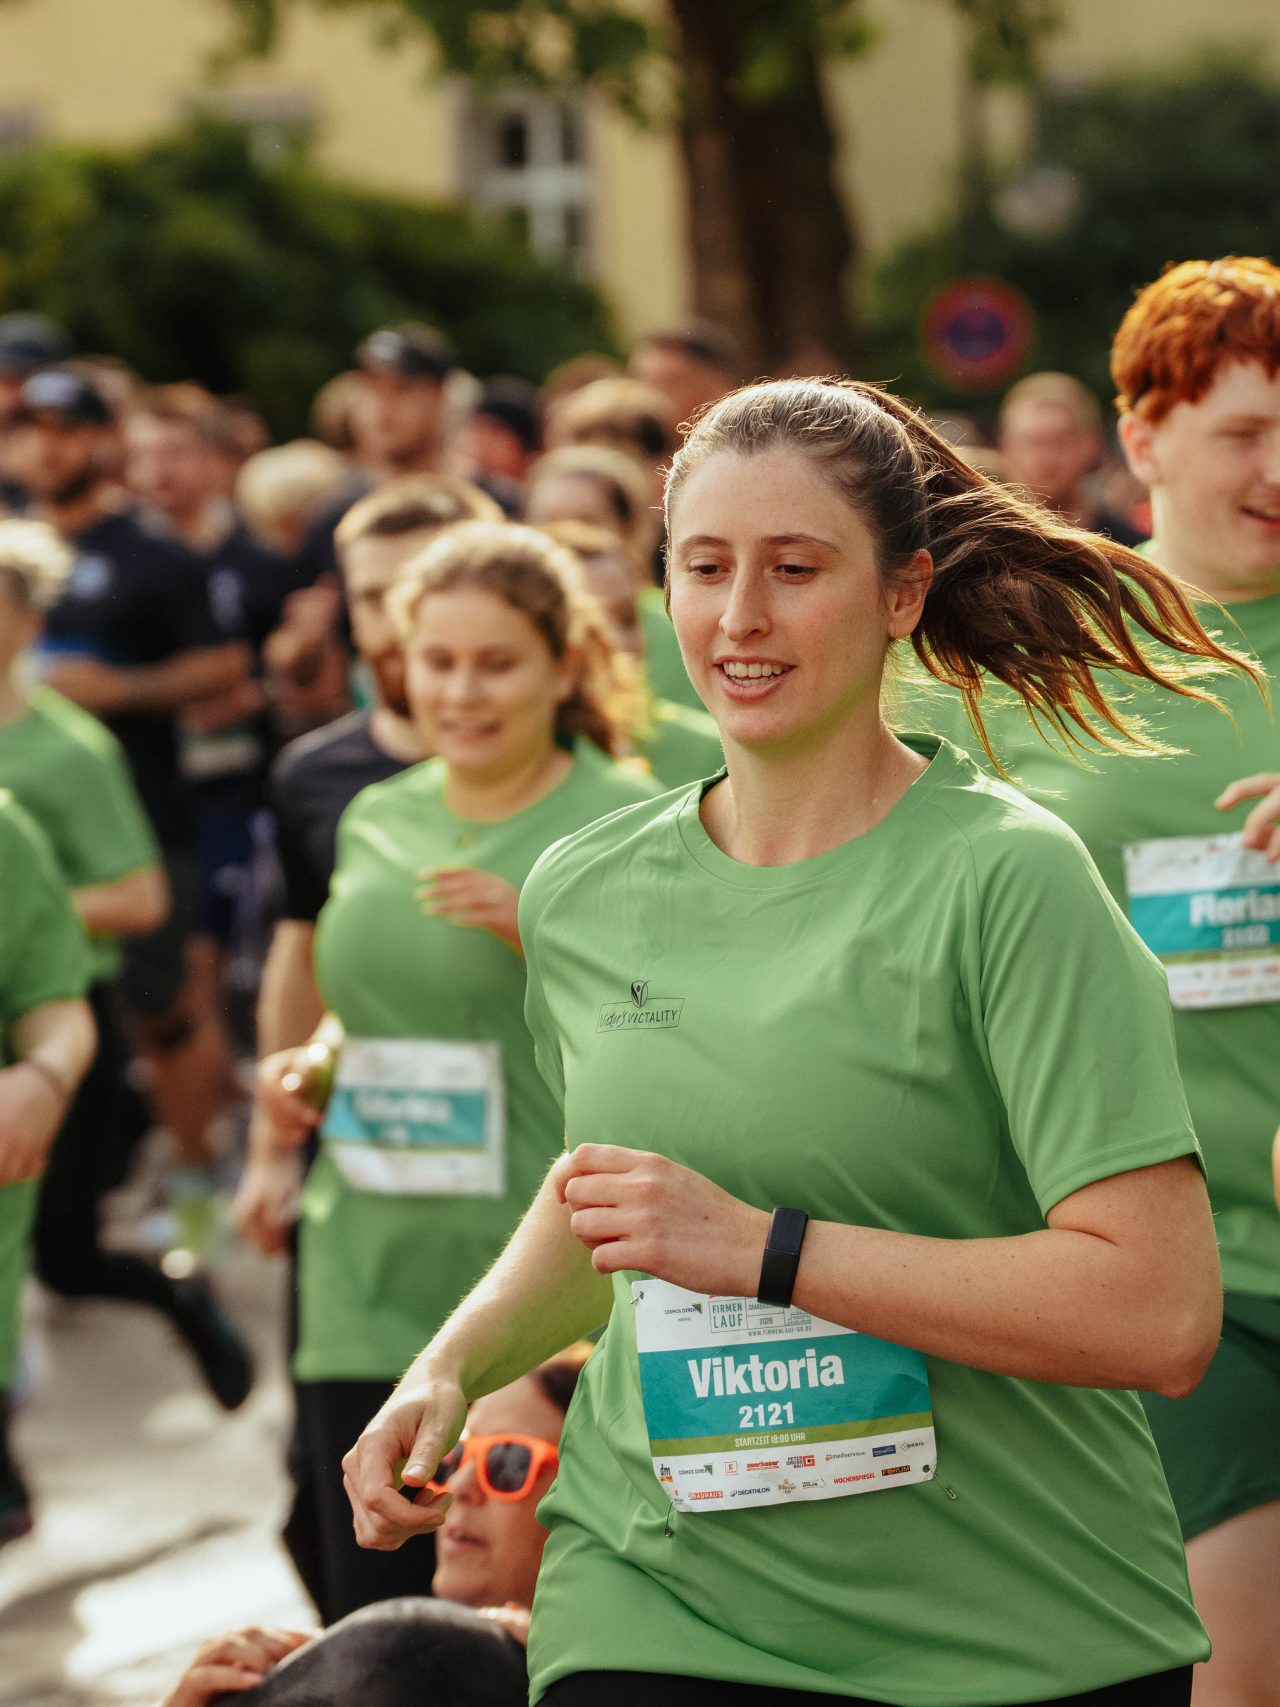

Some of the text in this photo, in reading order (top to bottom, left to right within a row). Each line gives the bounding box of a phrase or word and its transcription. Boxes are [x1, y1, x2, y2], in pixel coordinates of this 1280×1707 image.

[628, 1010, 678, 1024] VICTALITY
[712, 1302, 743, 1313] FIRMEN
[713, 1314, 743, 1329] LAUF
[687, 1348, 845, 1398] Viktoria
[738, 1402, 794, 1429] 2121
[735, 1432, 806, 1448] STARTZEIT 18:00 UHR
[660, 1464, 671, 1476] dm
[834, 1473, 875, 1485] WOCHENSPIEGEL
[691, 1491, 722, 1500] BAUHAUS
[738, 1487, 770, 1496] DECATHLON
